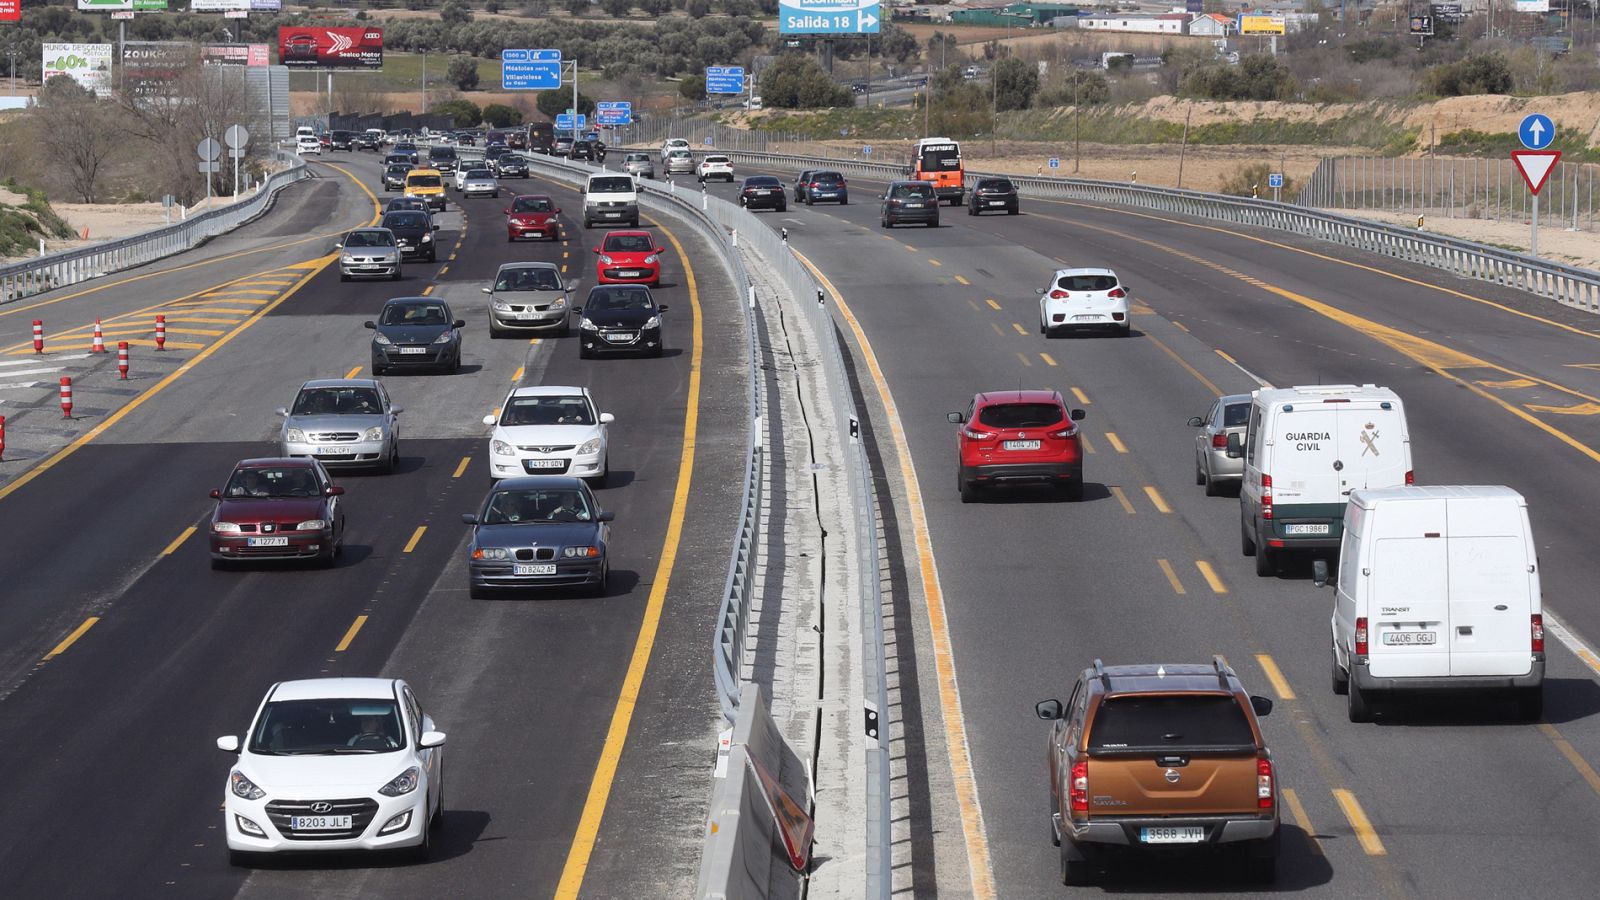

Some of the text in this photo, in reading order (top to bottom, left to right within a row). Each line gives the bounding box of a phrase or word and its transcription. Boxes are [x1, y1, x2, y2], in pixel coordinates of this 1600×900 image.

[787, 15, 850, 29] Salida 18
[1285, 432, 1331, 441] GUARDIA
[1296, 442, 1321, 451] CIVIL
[533, 460, 549, 468] 4121
[1290, 525, 1304, 533] PGC
[527, 565, 546, 574] 8242
[1389, 633, 1433, 643] 4406 GGJ
[299, 816, 349, 828] 8203 JLF
[1149, 828, 1202, 840] 3568 JVH
